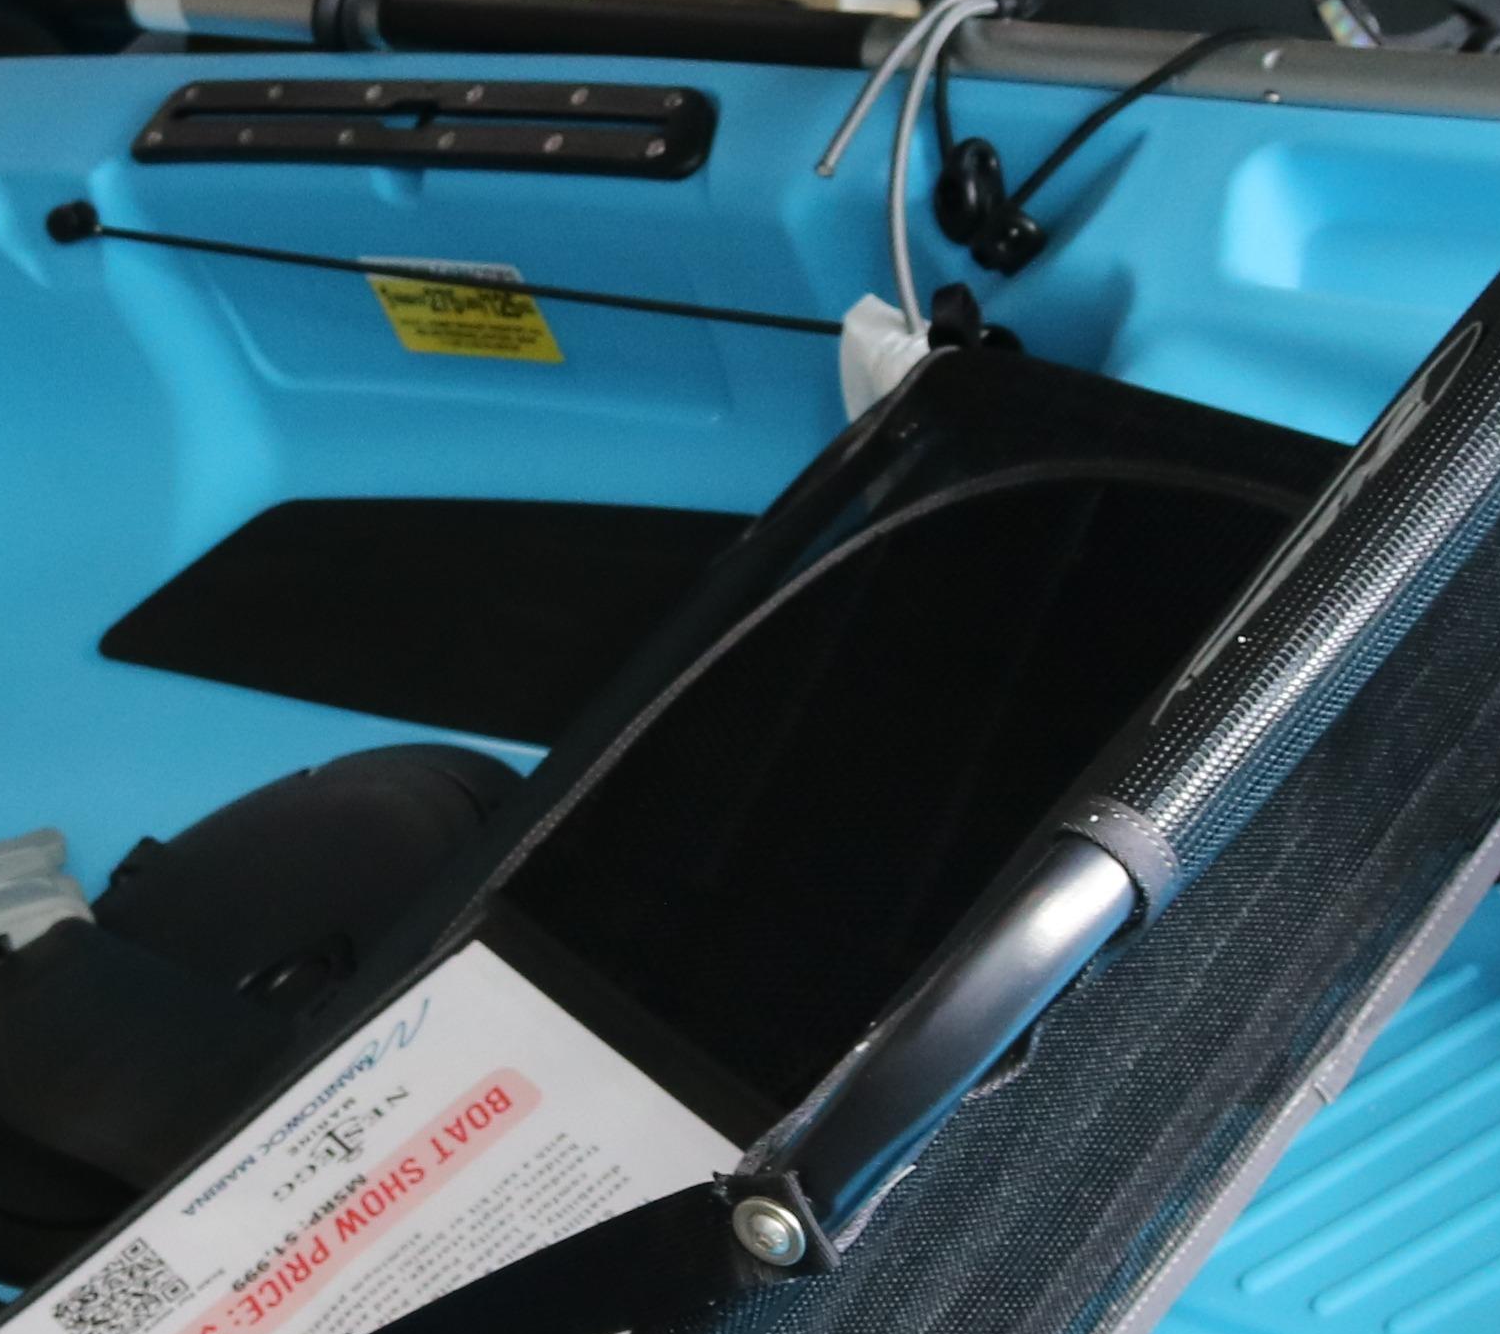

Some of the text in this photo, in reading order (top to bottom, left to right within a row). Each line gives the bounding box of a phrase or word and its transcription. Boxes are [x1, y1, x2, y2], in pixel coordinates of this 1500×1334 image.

[180, 1053, 377, 1216] MANITOWOC MARINA
[286, 1095, 357, 1156] MARINE
[429, 1085, 513, 1164] BOAT
[230, 1173, 368, 1294] MSRP: $1,999
[333, 1156, 425, 1243] SHOW
[226, 1234, 331, 1325] PRICE:
